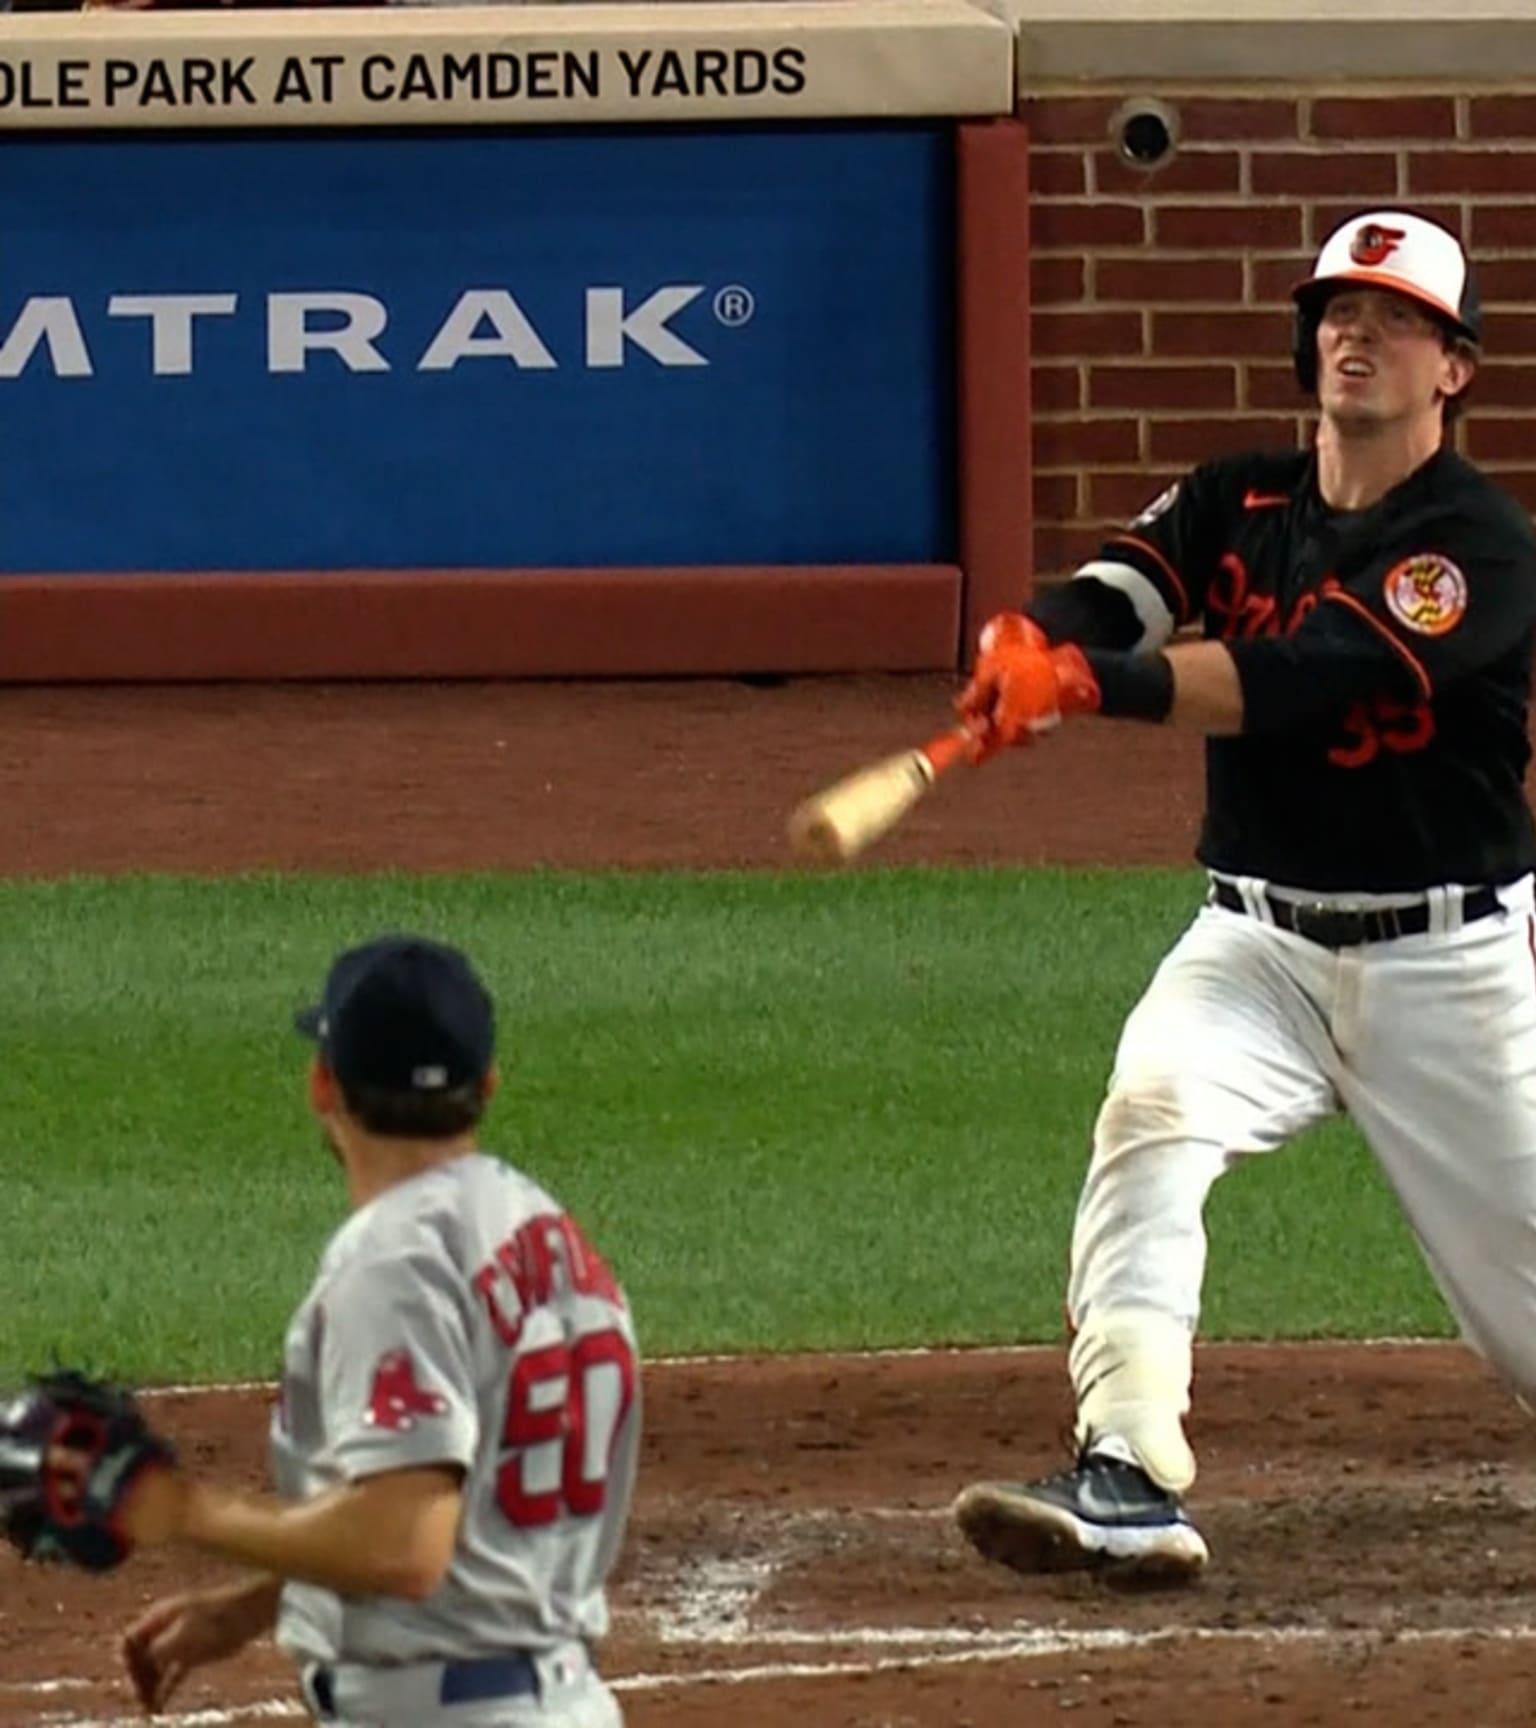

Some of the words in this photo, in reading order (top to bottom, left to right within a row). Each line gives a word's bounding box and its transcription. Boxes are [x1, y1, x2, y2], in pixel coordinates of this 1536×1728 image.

[104, 58, 256, 106] PARK
[273, 56, 345, 104] AT
[361, 51, 599, 101] CAMDEN
[617, 47, 806, 97] YARDS
[495, 1327, 634, 1532] 50
